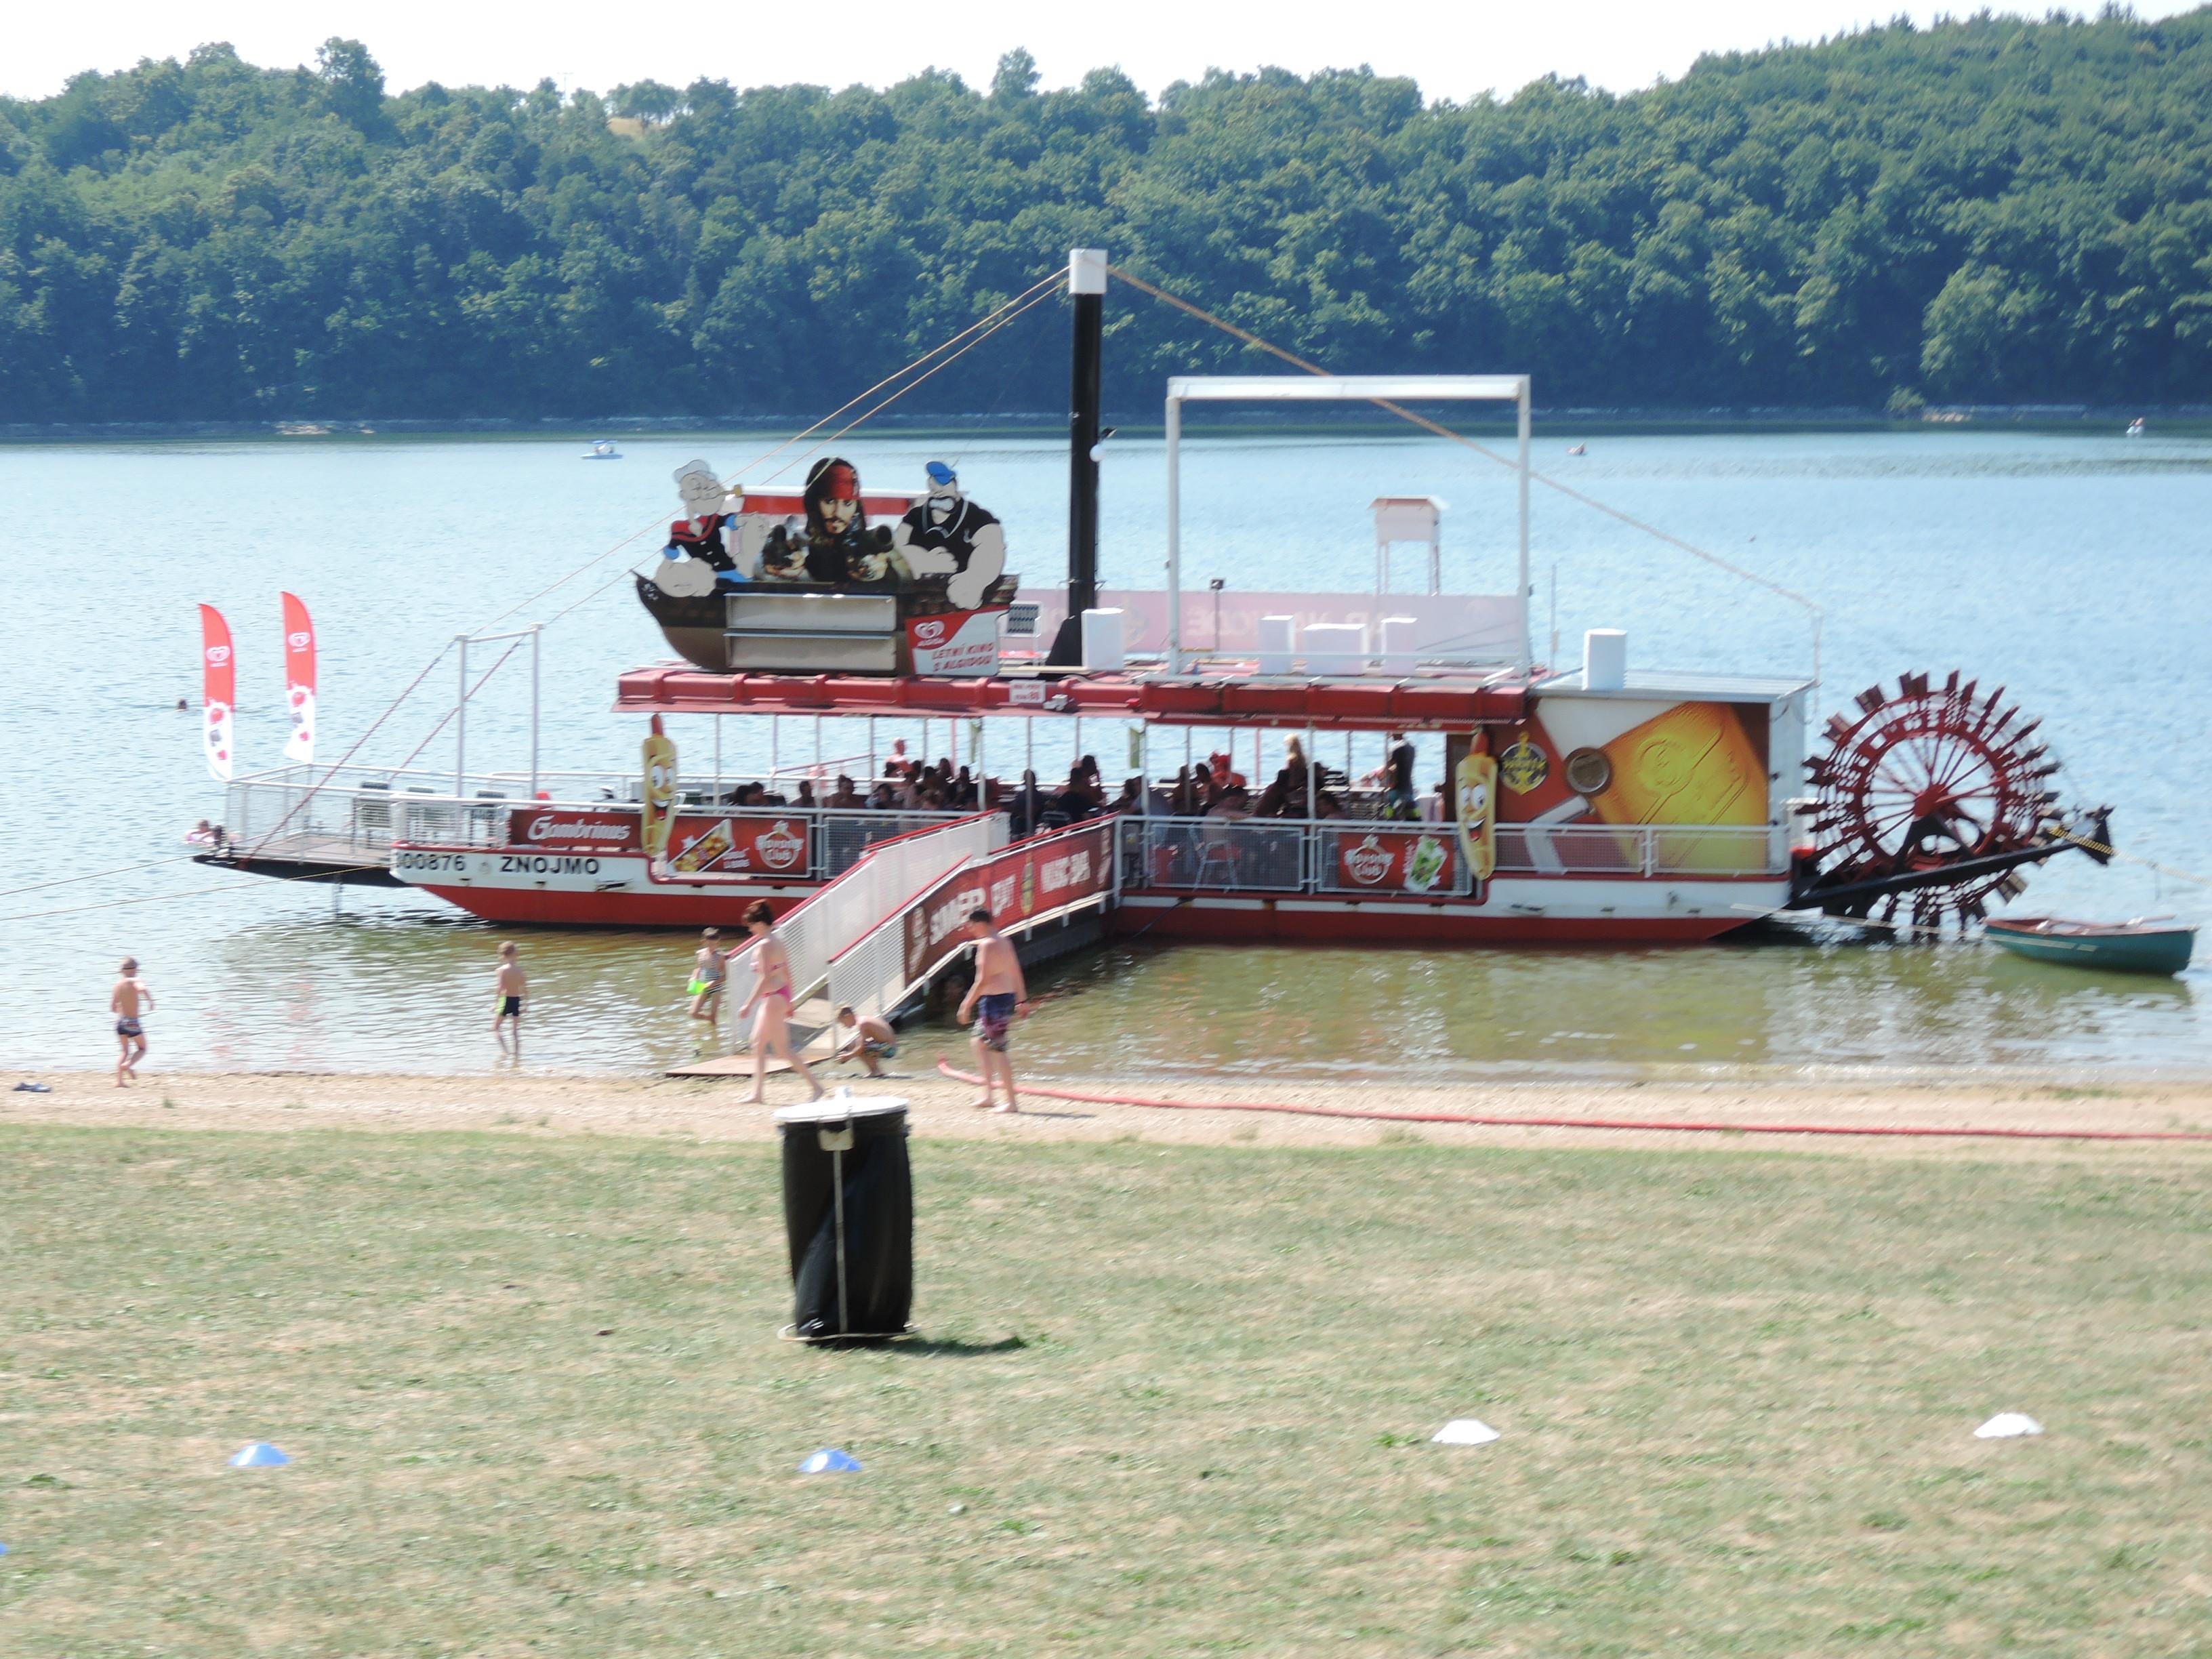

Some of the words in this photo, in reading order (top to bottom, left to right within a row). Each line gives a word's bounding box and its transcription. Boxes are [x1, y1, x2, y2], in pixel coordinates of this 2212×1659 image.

[968, 642, 995, 654] KINO
[527, 815, 631, 840] Gambrinus
[499, 855, 599, 875] ZNOJMO
